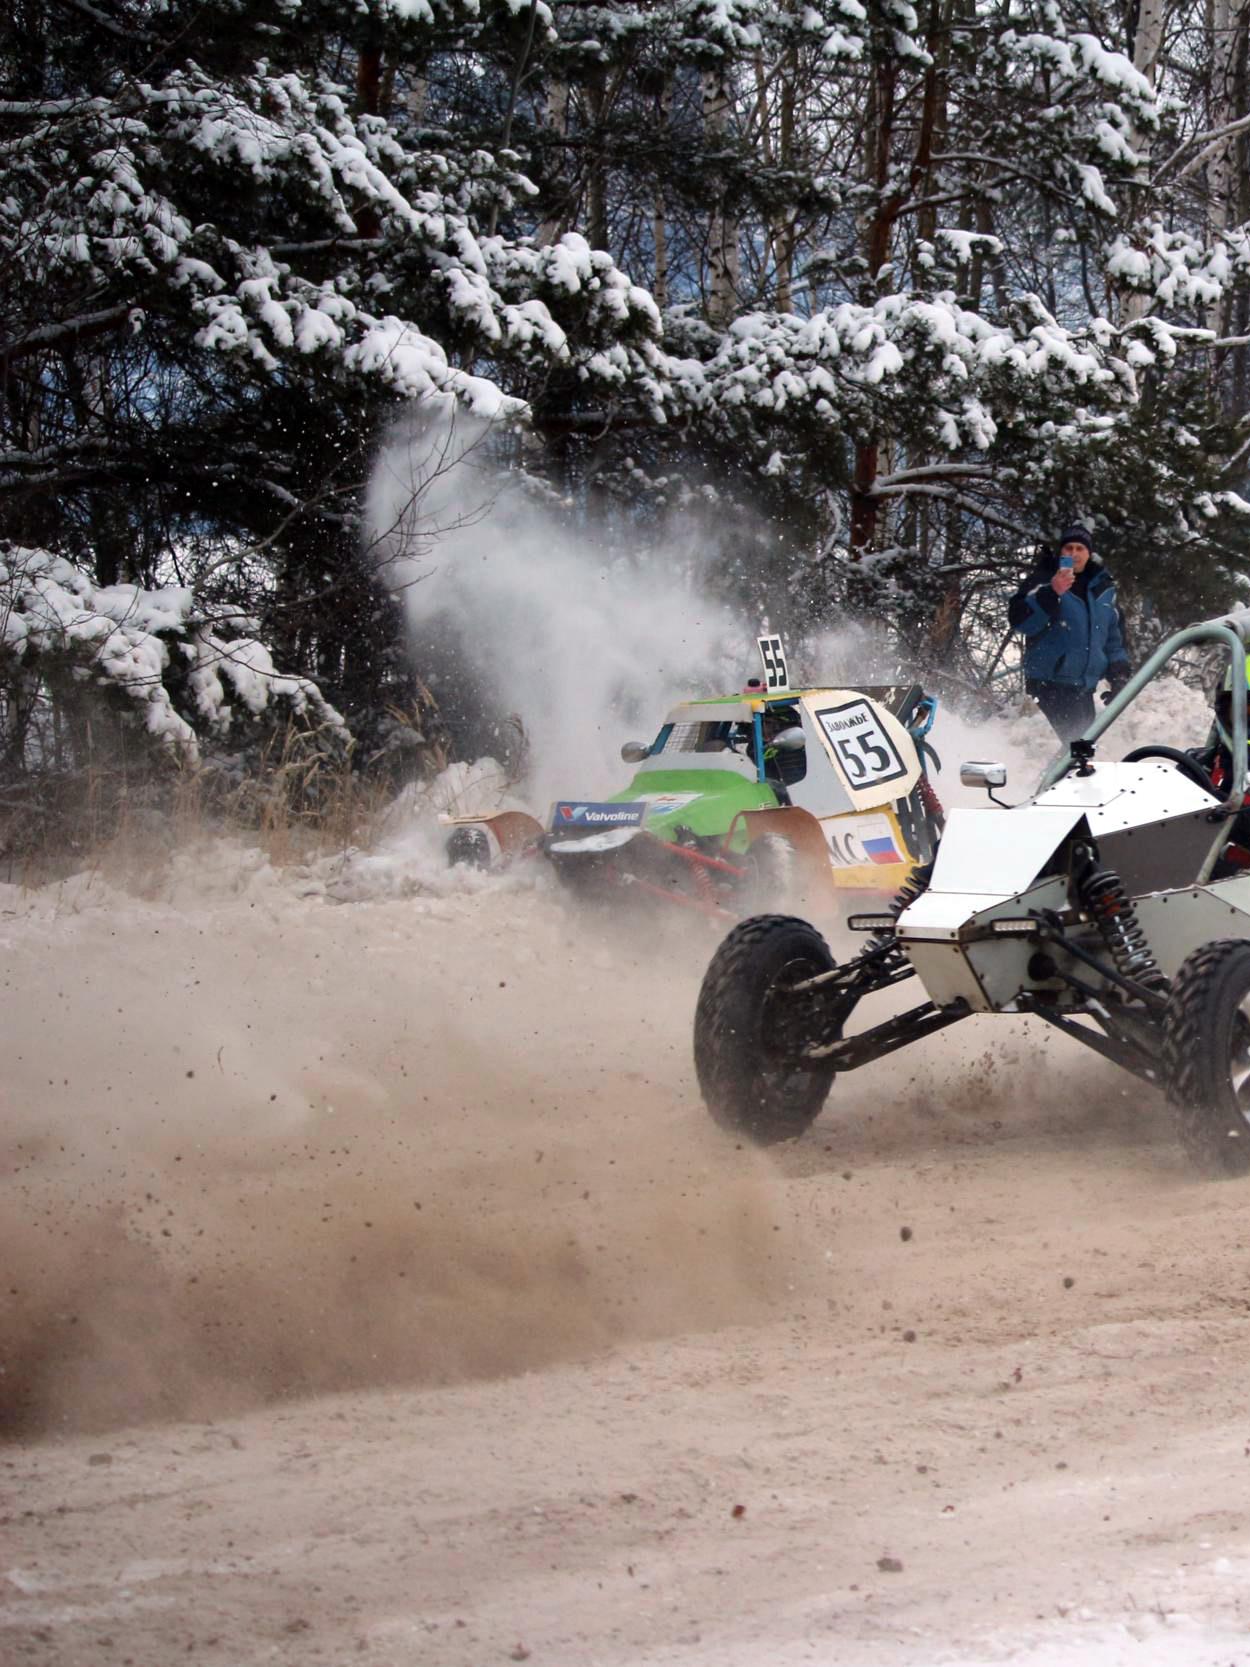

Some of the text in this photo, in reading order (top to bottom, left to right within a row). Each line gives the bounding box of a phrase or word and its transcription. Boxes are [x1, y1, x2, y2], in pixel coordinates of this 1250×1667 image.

[760, 640, 787, 687] 55
[838, 730, 891, 777] 55
[585, 811, 639, 822] Valvoline
